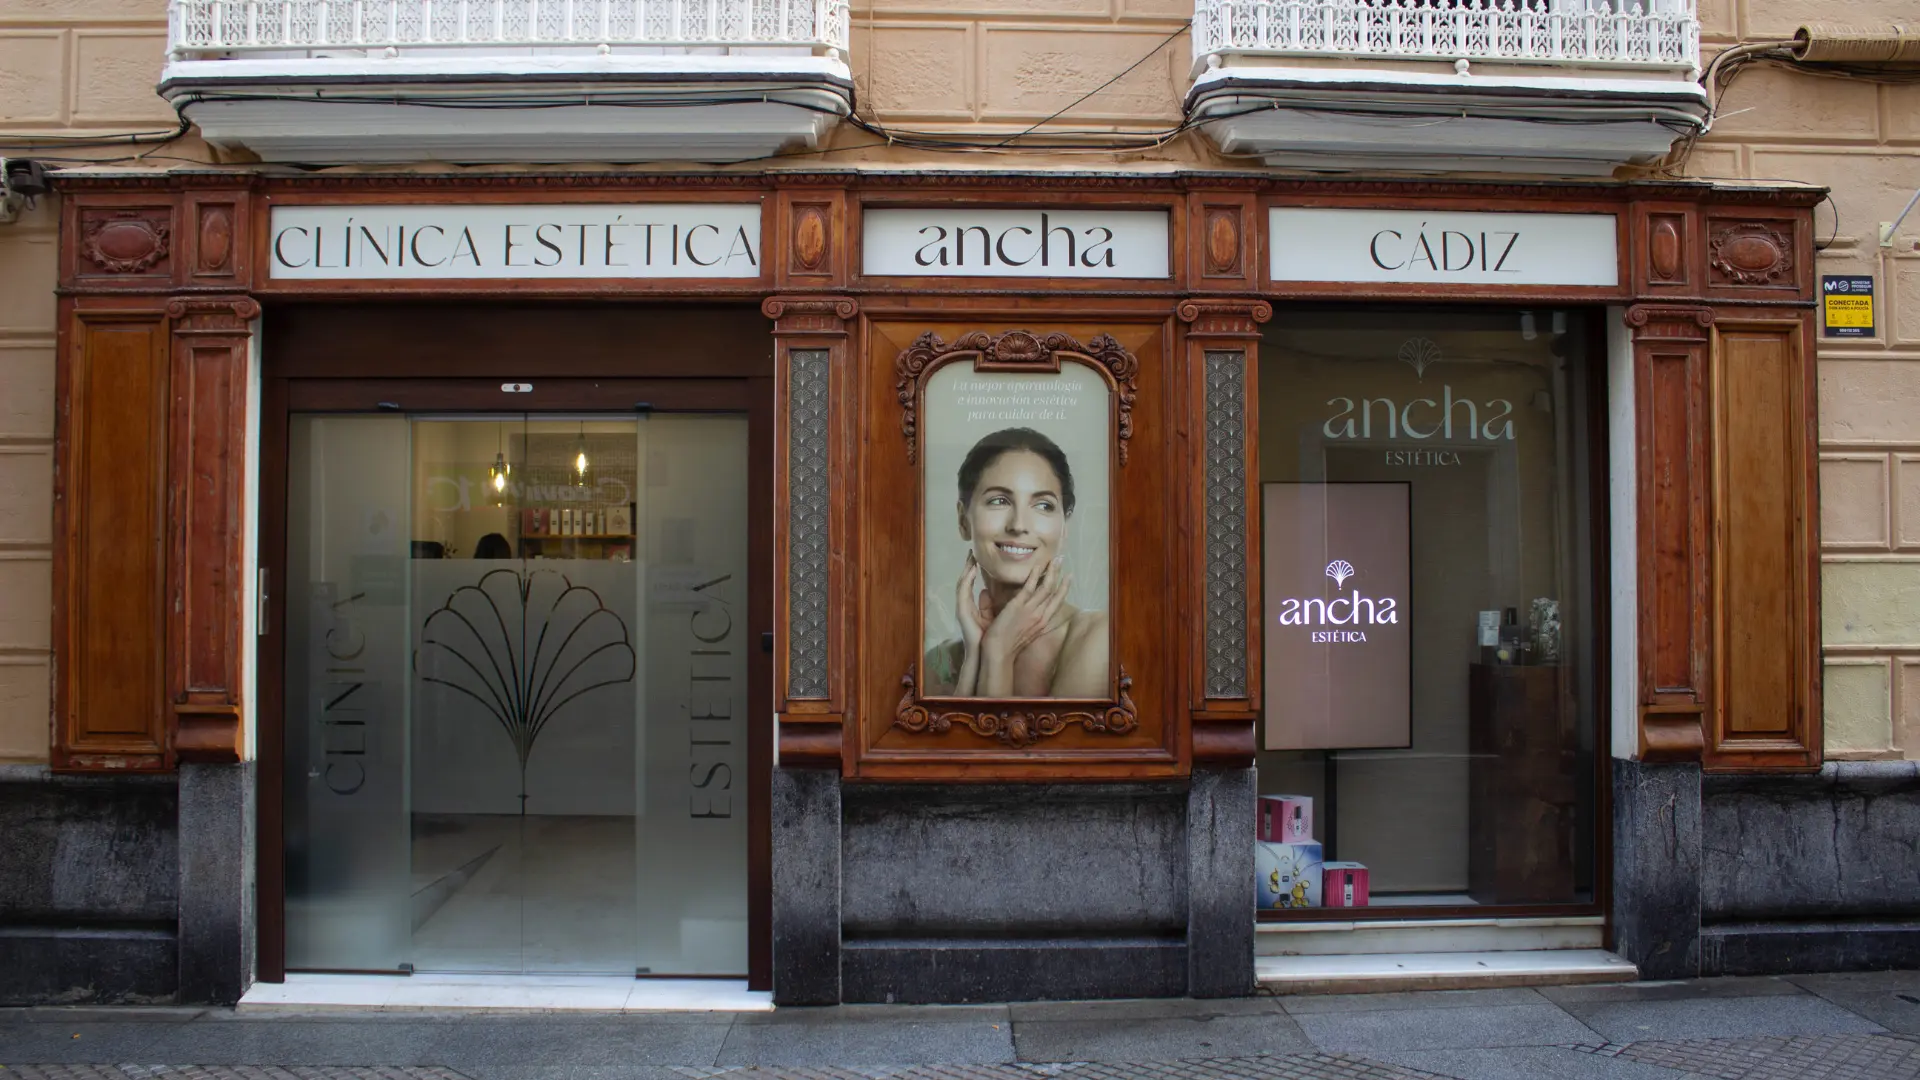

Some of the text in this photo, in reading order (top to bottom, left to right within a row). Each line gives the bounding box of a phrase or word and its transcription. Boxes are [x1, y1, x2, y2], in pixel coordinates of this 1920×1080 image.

[274, 214, 757, 268] CLÍNICA ESTÉTICA
[914, 212, 1117, 268] ancha
[1370, 221, 1522, 273] CÁDIZ
[970, 381, 1004, 393] mejor
[1032, 393, 1078, 406] estética
[967, 411, 996, 422] para
[998, 408, 1037, 420] cuidar
[1039, 408, 1054, 420] de
[1323, 385, 1516, 440] ancha
[1385, 448, 1461, 466] ESTÉTICA
[1279, 589, 1398, 626] ancha
[1311, 629, 1367, 643] ESTÉTICA
[680, 573, 732, 819] ESTÉTICA
